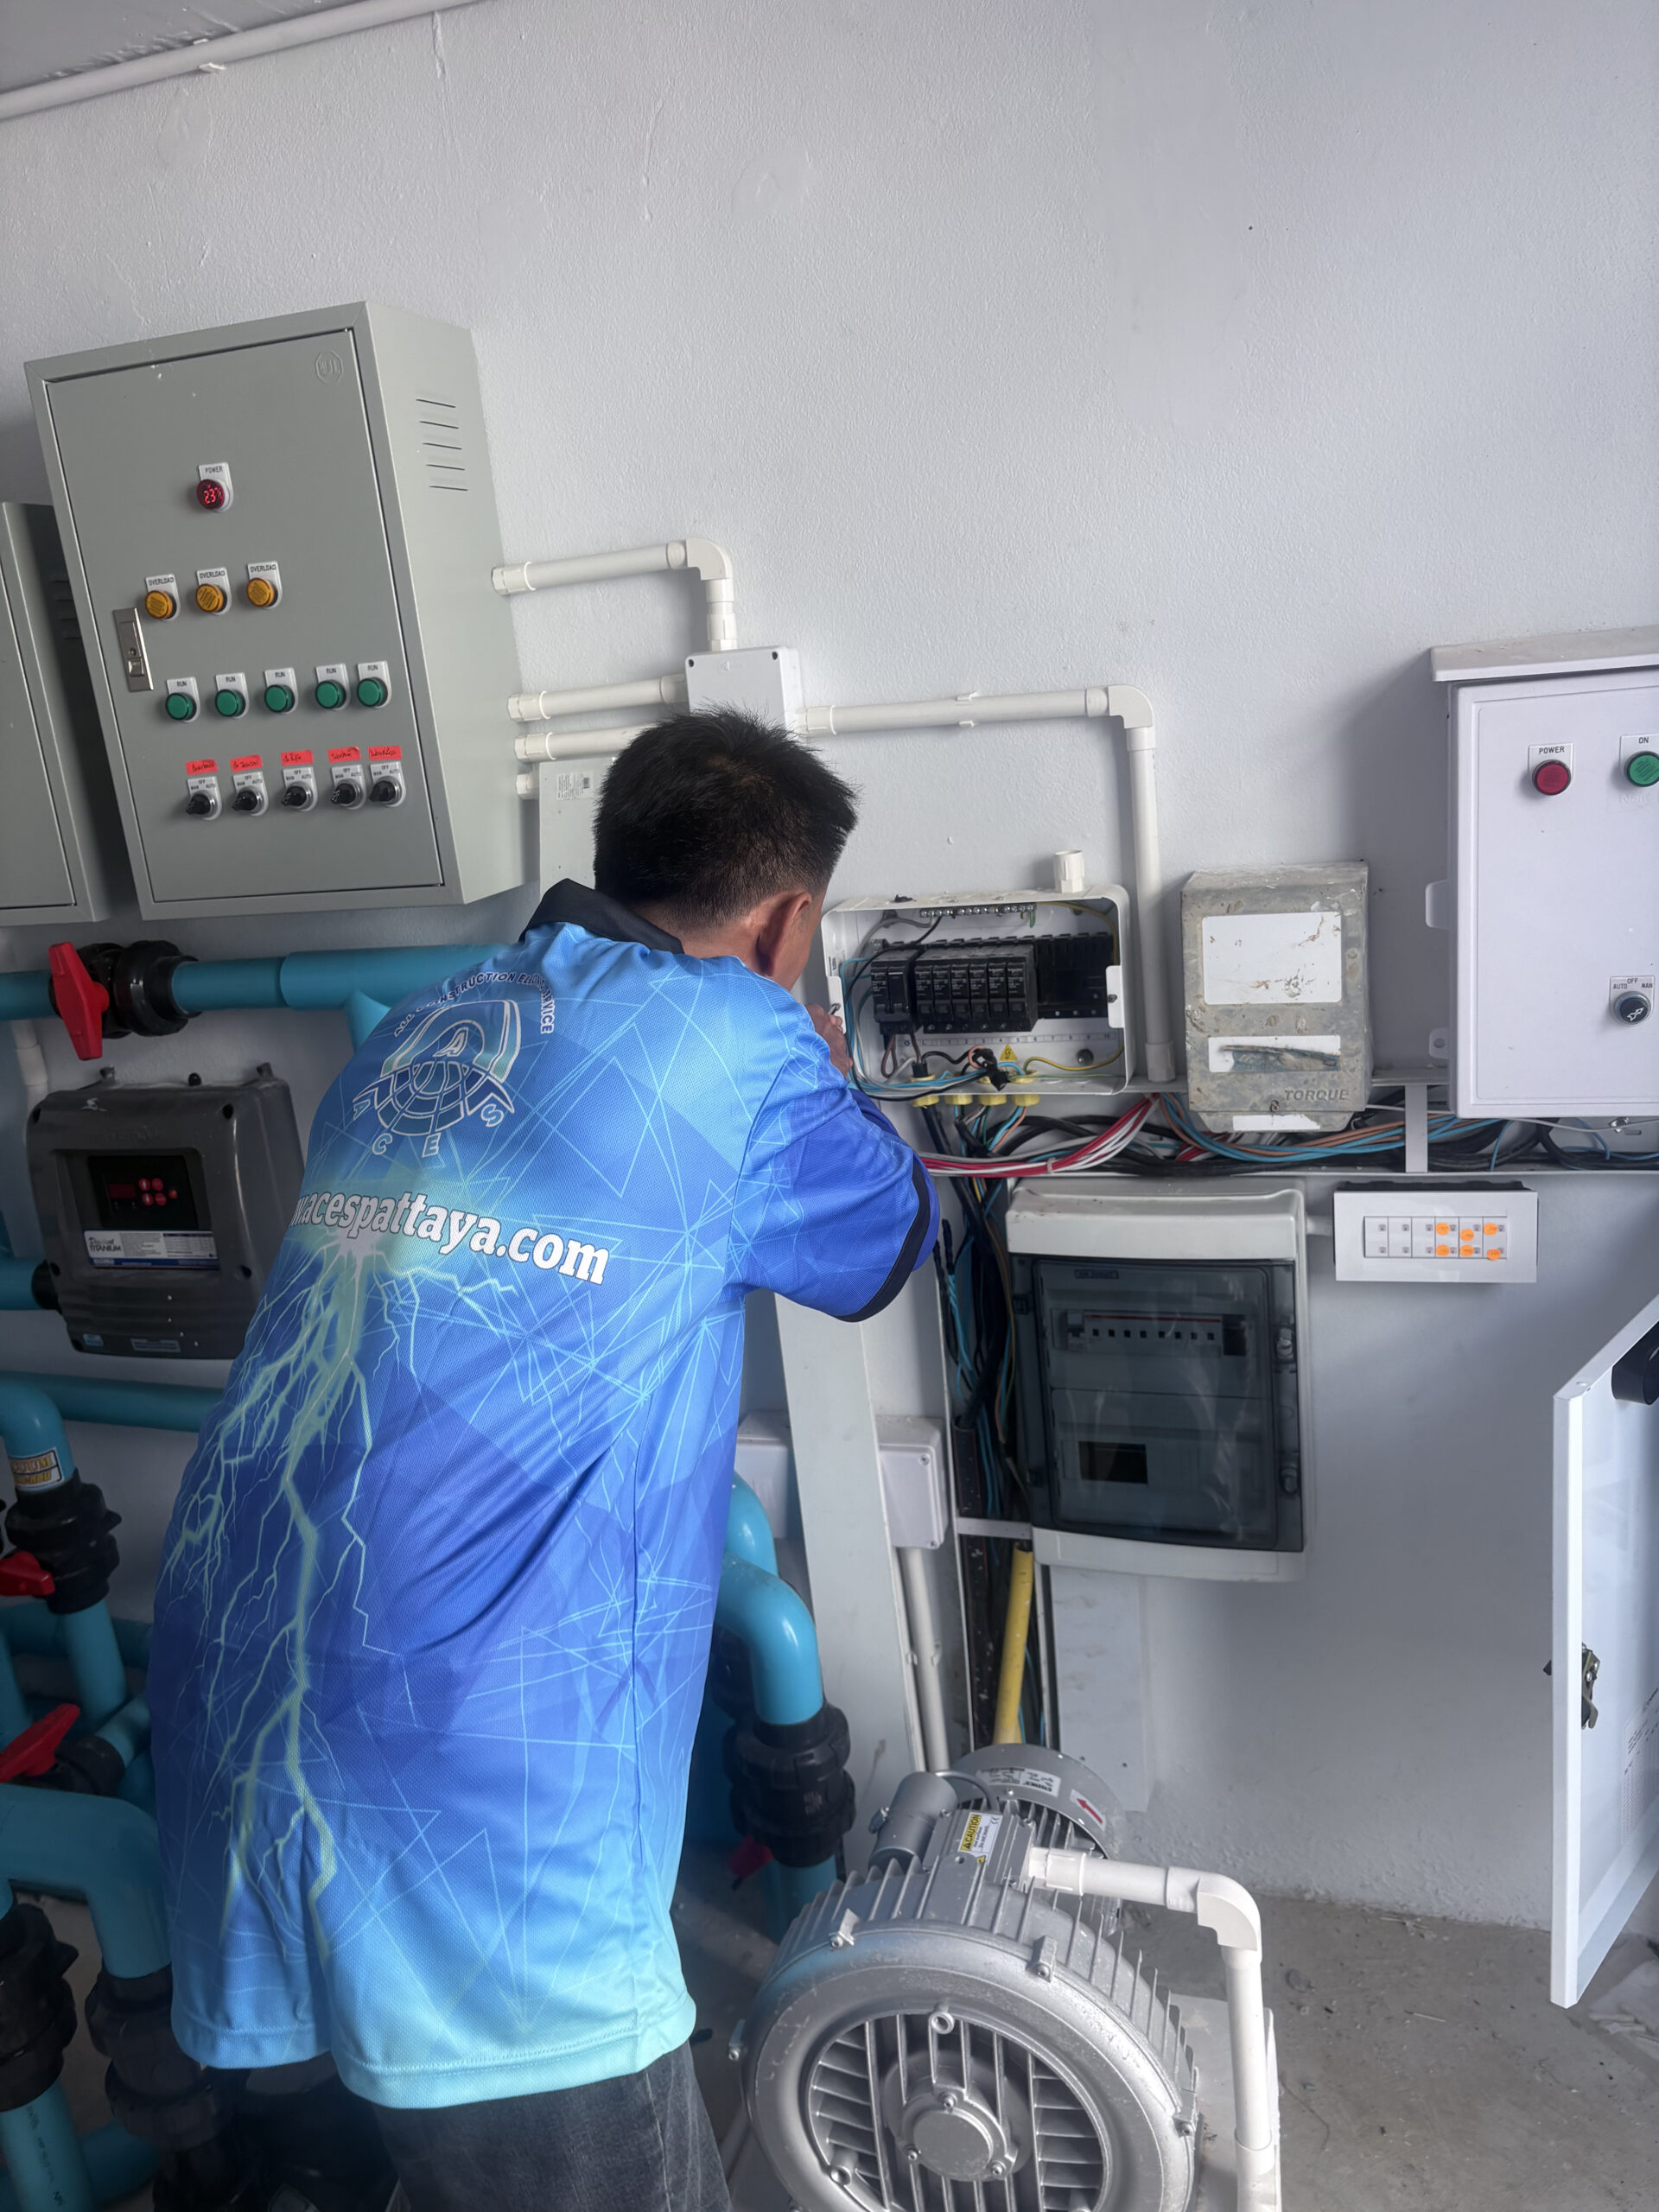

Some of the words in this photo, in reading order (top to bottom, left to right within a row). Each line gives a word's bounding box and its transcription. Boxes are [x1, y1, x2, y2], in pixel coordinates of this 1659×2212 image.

[250, 564, 276, 573] OVERLOAD
[199, 570, 226, 579] OVERLOAD
[148, 576, 174, 586] OVERLOAD
[1539, 746, 1565, 754] POWER
[1284, 1089, 1350, 1101] TORQUE
[965, 1814, 981, 1842] CAUTION
